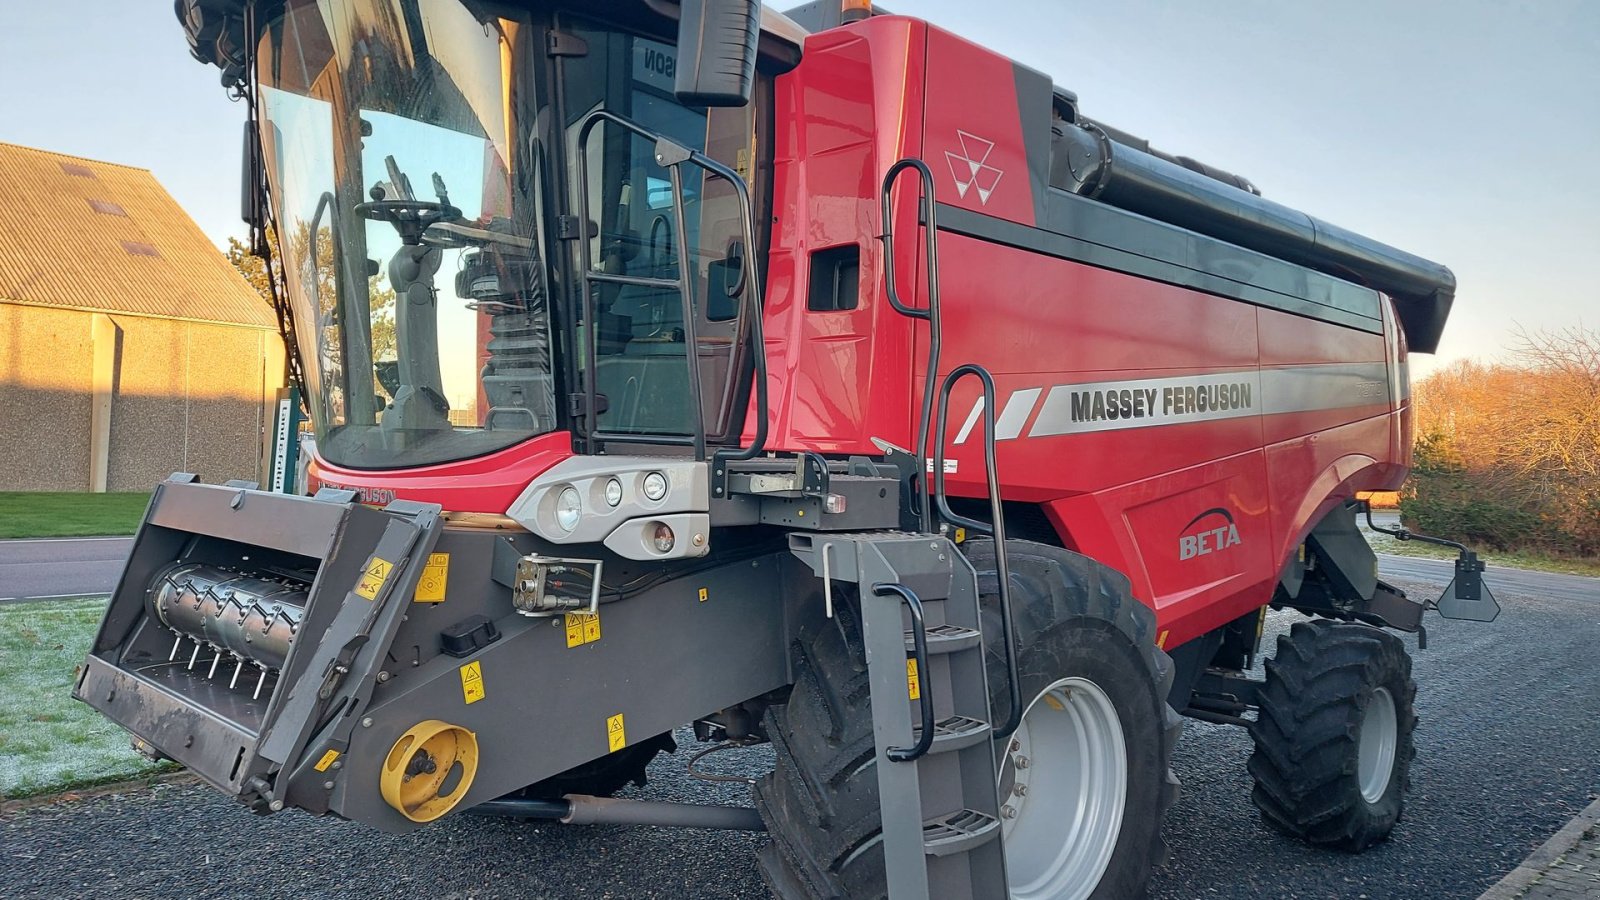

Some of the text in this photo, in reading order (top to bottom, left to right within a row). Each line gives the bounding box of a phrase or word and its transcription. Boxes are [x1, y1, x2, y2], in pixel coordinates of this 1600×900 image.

[1071, 382, 1252, 422] MASSEY FERGUSON
[1179, 523, 1241, 561] BETA
